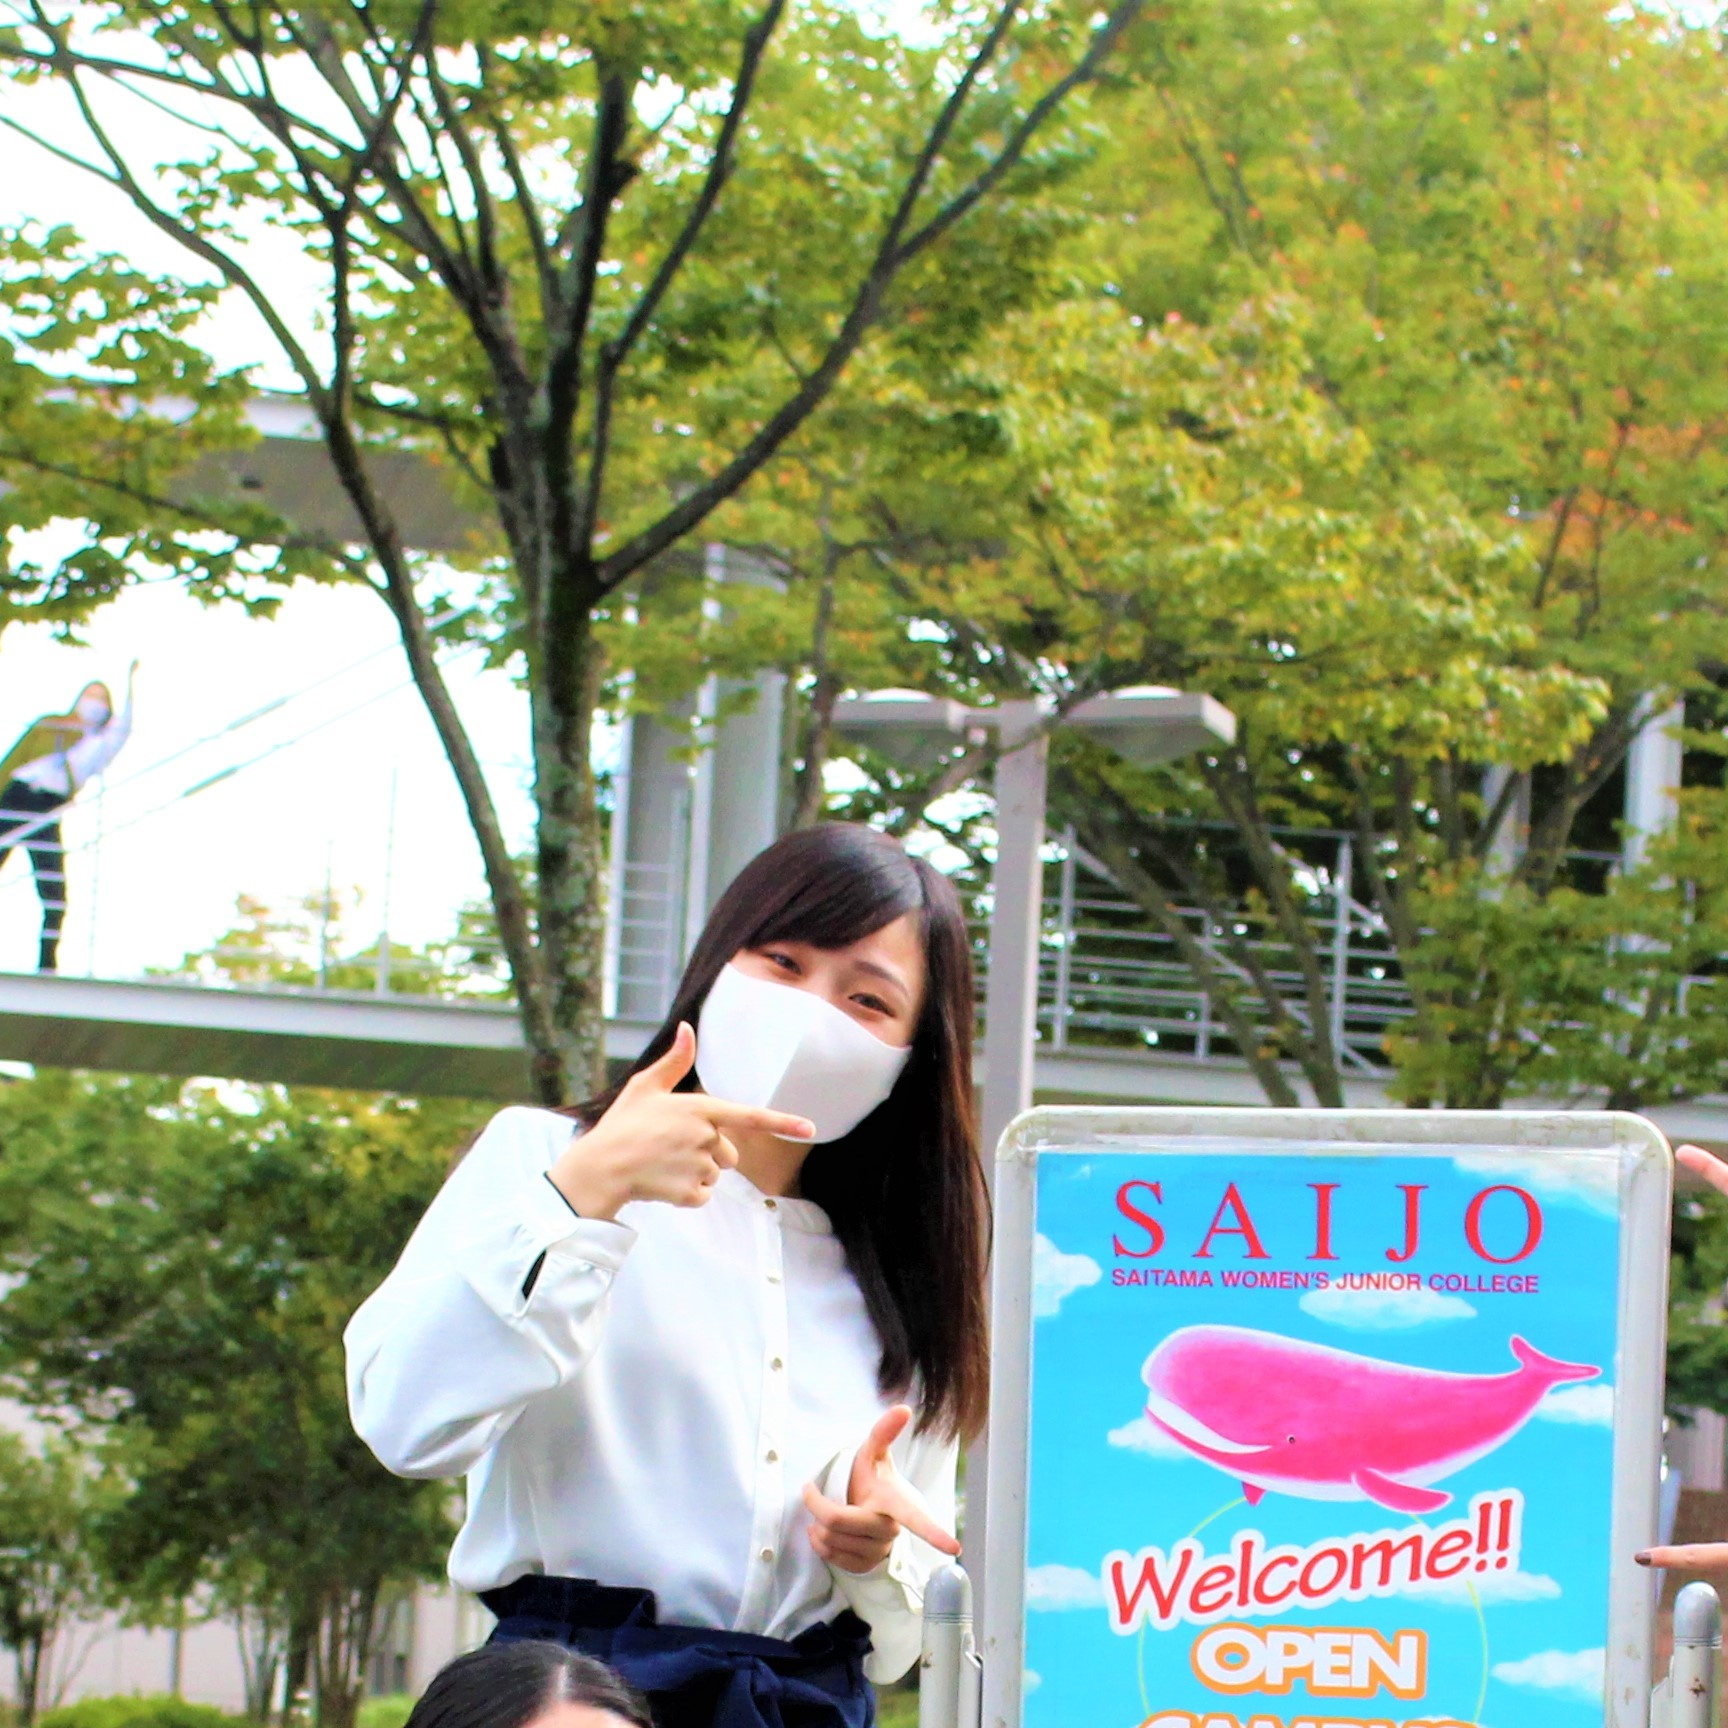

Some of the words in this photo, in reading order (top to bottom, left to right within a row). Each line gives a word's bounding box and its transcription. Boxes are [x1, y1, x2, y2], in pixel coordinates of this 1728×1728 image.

[1111, 1179, 1545, 1265] SAIJO
[1111, 1268, 1214, 1288] SAITAMA
[1220, 1270, 1330, 1291] WOMEN'S
[1335, 1273, 1423, 1293] JUNIOR
[1428, 1274, 1540, 1294] COLLEGE
[1109, 1497, 1516, 1627] Welcome!!
[1195, 1628, 1422, 1693] OPEN
